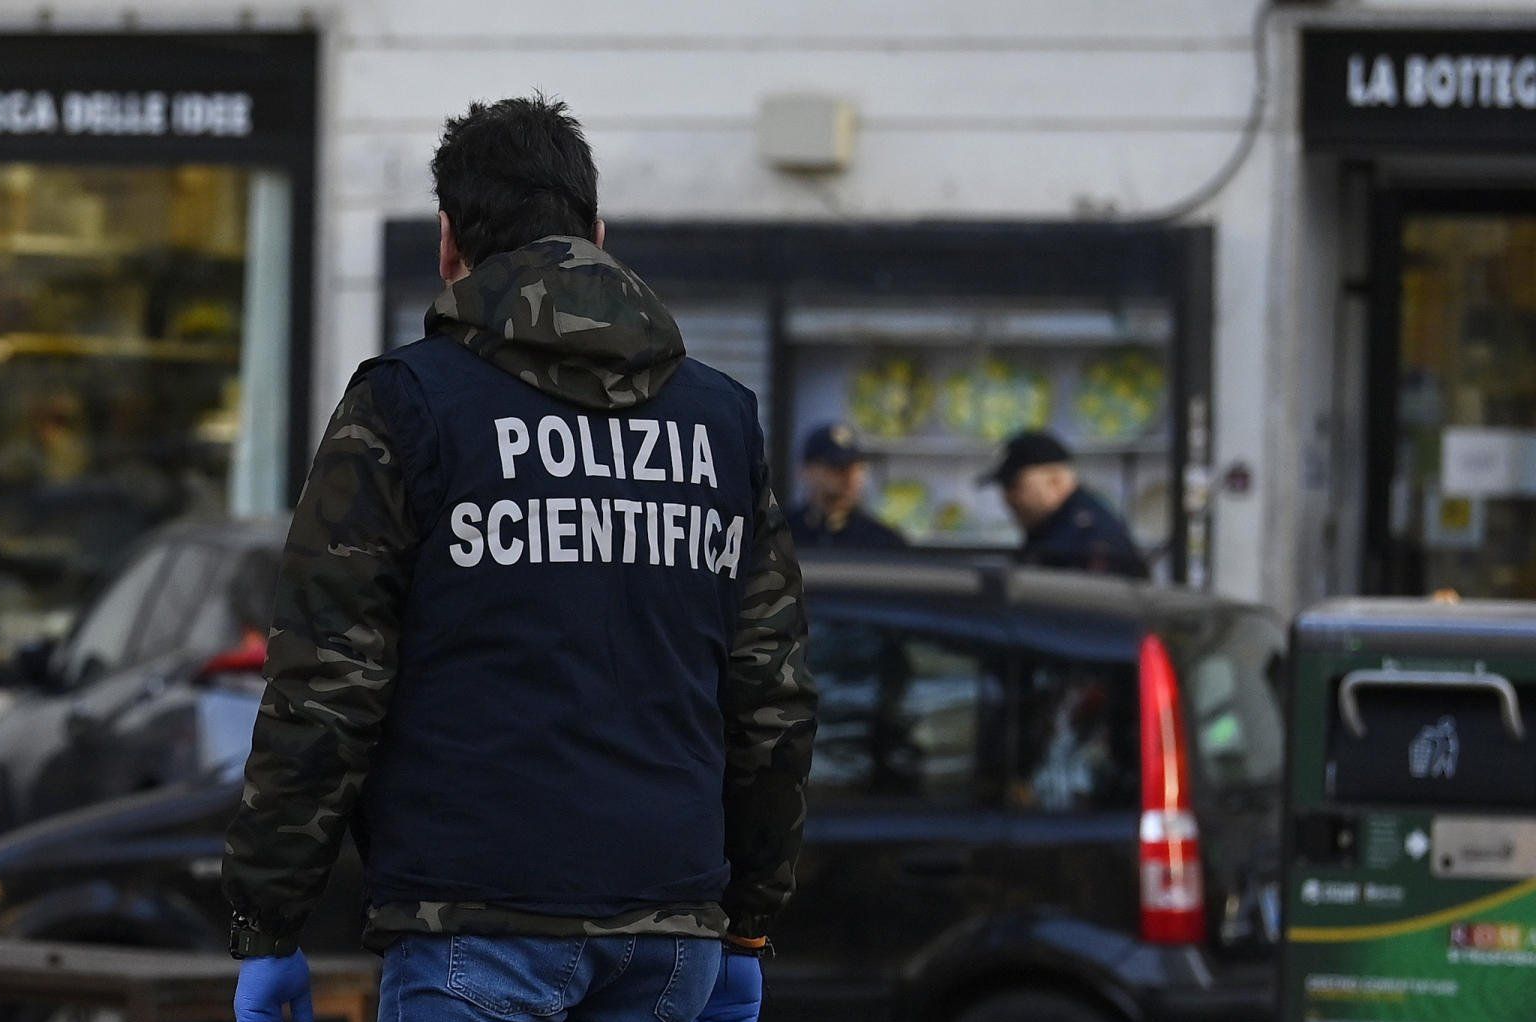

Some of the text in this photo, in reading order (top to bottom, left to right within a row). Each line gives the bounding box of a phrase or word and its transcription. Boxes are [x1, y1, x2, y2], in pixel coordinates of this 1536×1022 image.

[1347, 54, 1398, 107] LA
[64, 91, 165, 135] DELLE
[494, 415, 718, 488] POLIZIA
[449, 498, 745, 579] SCIENTIFICA
